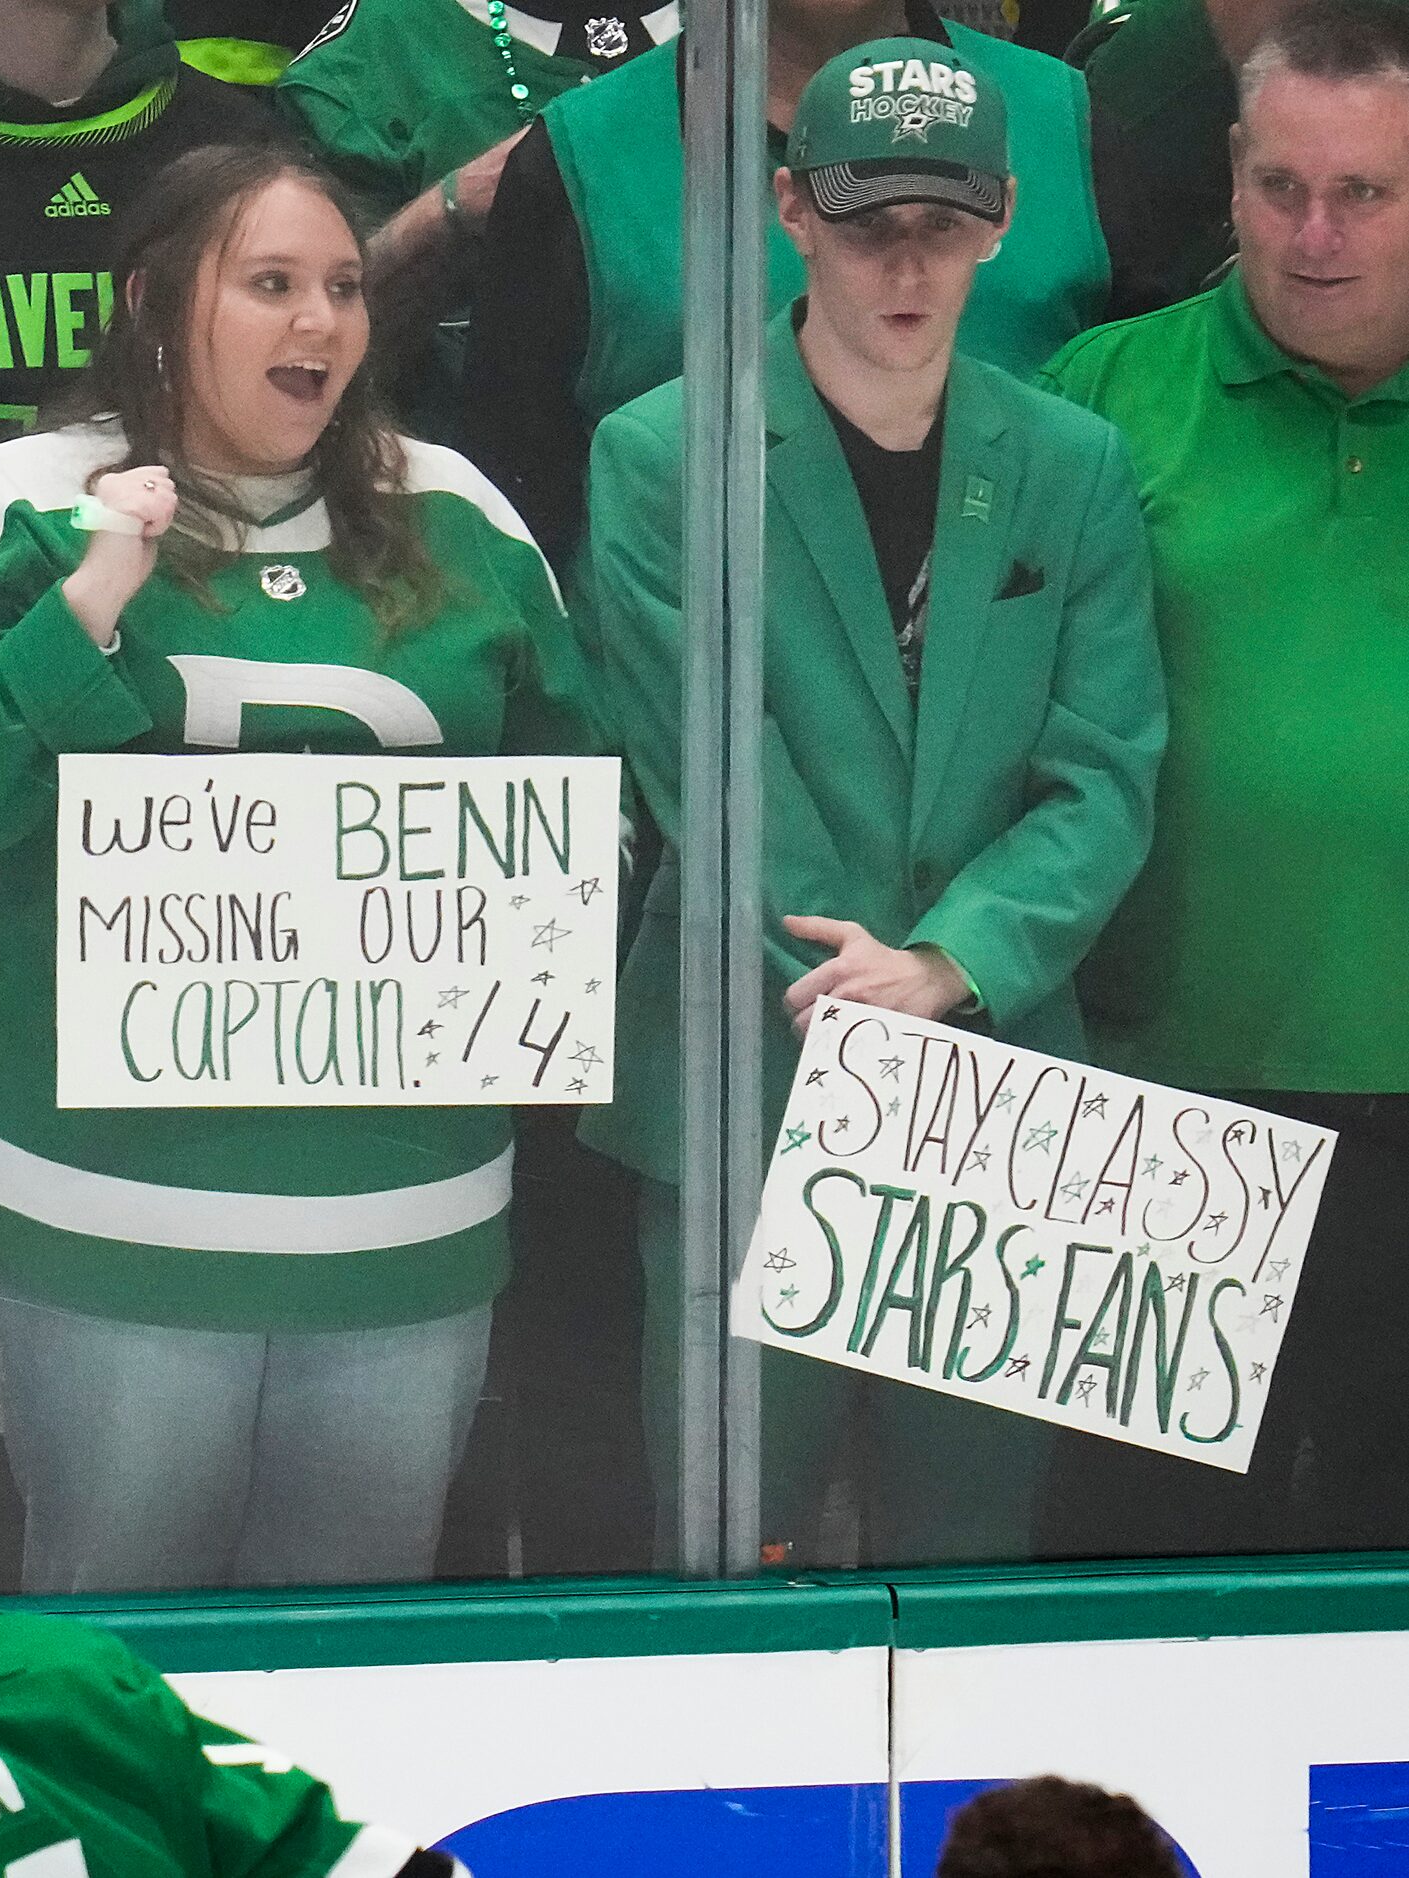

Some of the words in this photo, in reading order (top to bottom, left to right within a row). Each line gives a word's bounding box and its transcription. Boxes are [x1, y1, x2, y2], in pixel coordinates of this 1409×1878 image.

[849, 59, 977, 104] STARS
[850, 93, 974, 127] HOCKEY
[44, 200, 112, 217] adidas
[335, 776, 571, 881] BENN
[78, 891, 299, 964] MISSING
[360, 885, 487, 966] OUR
[817, 1018, 1015, 1187] STAY
[1008, 1066, 1327, 1284] CLASSY
[761, 1167, 1036, 1384] STARS
[1037, 1242, 1248, 1444] FANS
